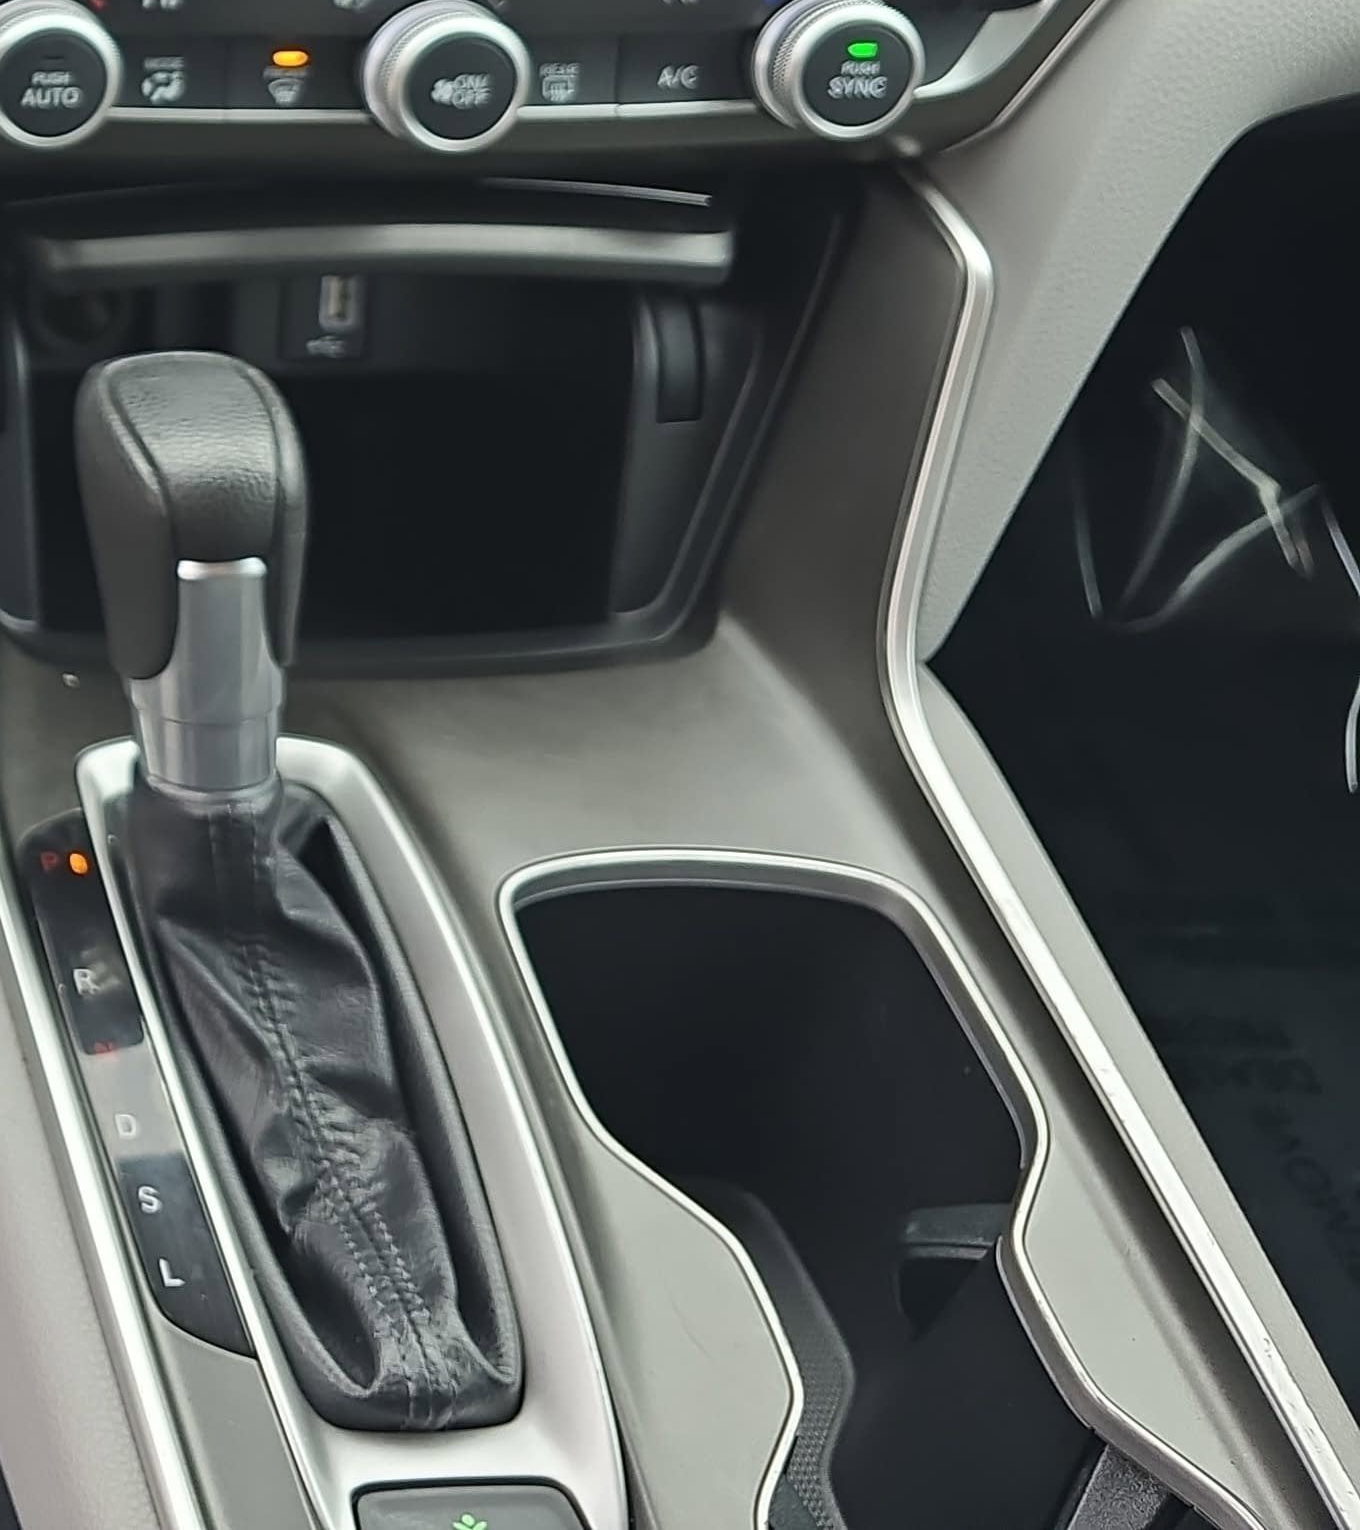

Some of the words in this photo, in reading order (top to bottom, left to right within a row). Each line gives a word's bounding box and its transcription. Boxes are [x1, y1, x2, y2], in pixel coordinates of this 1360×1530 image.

[656, 64, 700, 90] A/C
[827, 75, 888, 100] SYNC
[20, 85, 84, 110] AUTO
[114, 1112, 140, 1141] D
[136, 1185, 164, 1215] S
[157, 1257, 186, 1288] L
